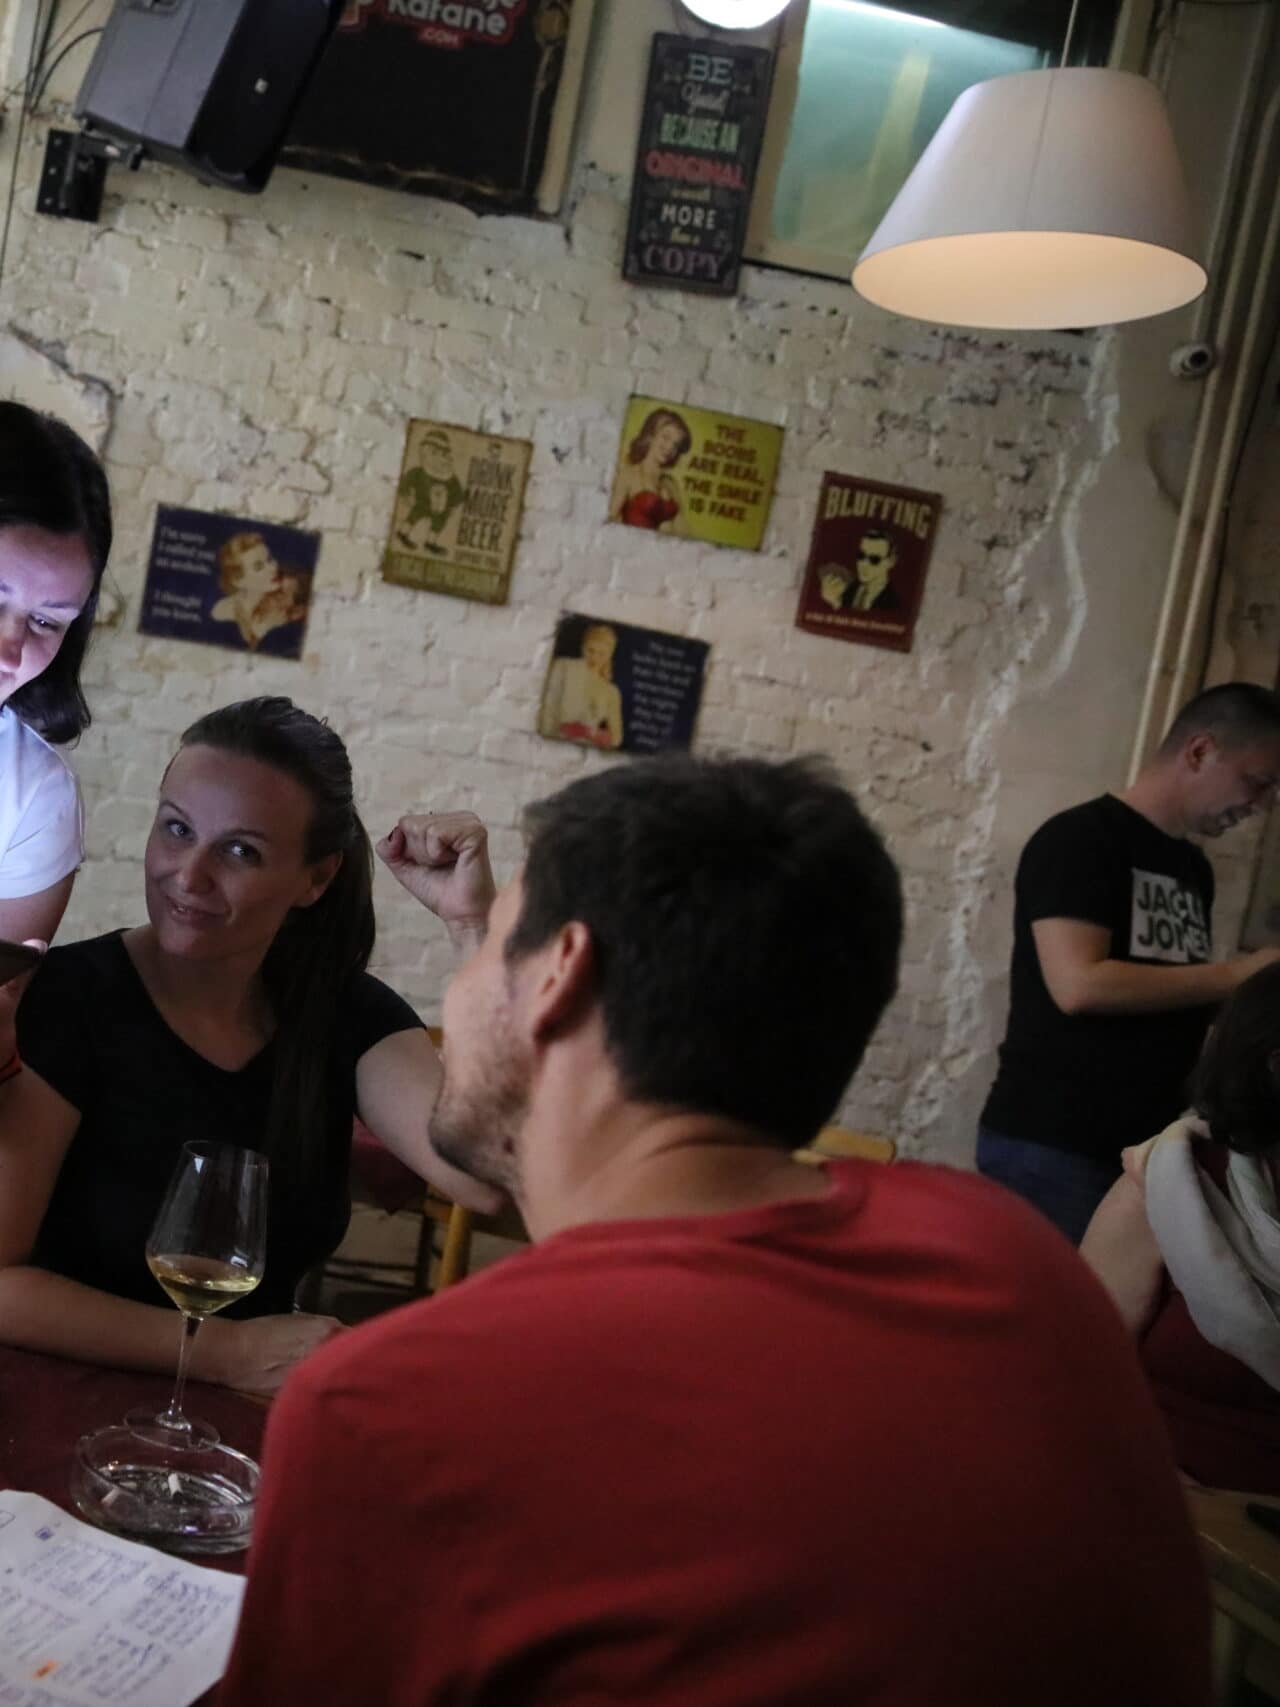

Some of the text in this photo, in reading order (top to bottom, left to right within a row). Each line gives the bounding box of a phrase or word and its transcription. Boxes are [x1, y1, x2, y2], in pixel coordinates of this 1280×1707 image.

[686, 54, 734, 84] BE
[661, 113, 716, 150] BECAUSE
[645, 151, 746, 189] ORIGINAL
[660, 203, 717, 230] MORE
[644, 245, 720, 279] COPY
[717, 424, 747, 443] THE
[688, 456, 719, 474] ARE
[683, 476, 762, 506] THE SMILE
[689, 498, 705, 514] IS
[825, 486, 932, 539] BLUFFING
